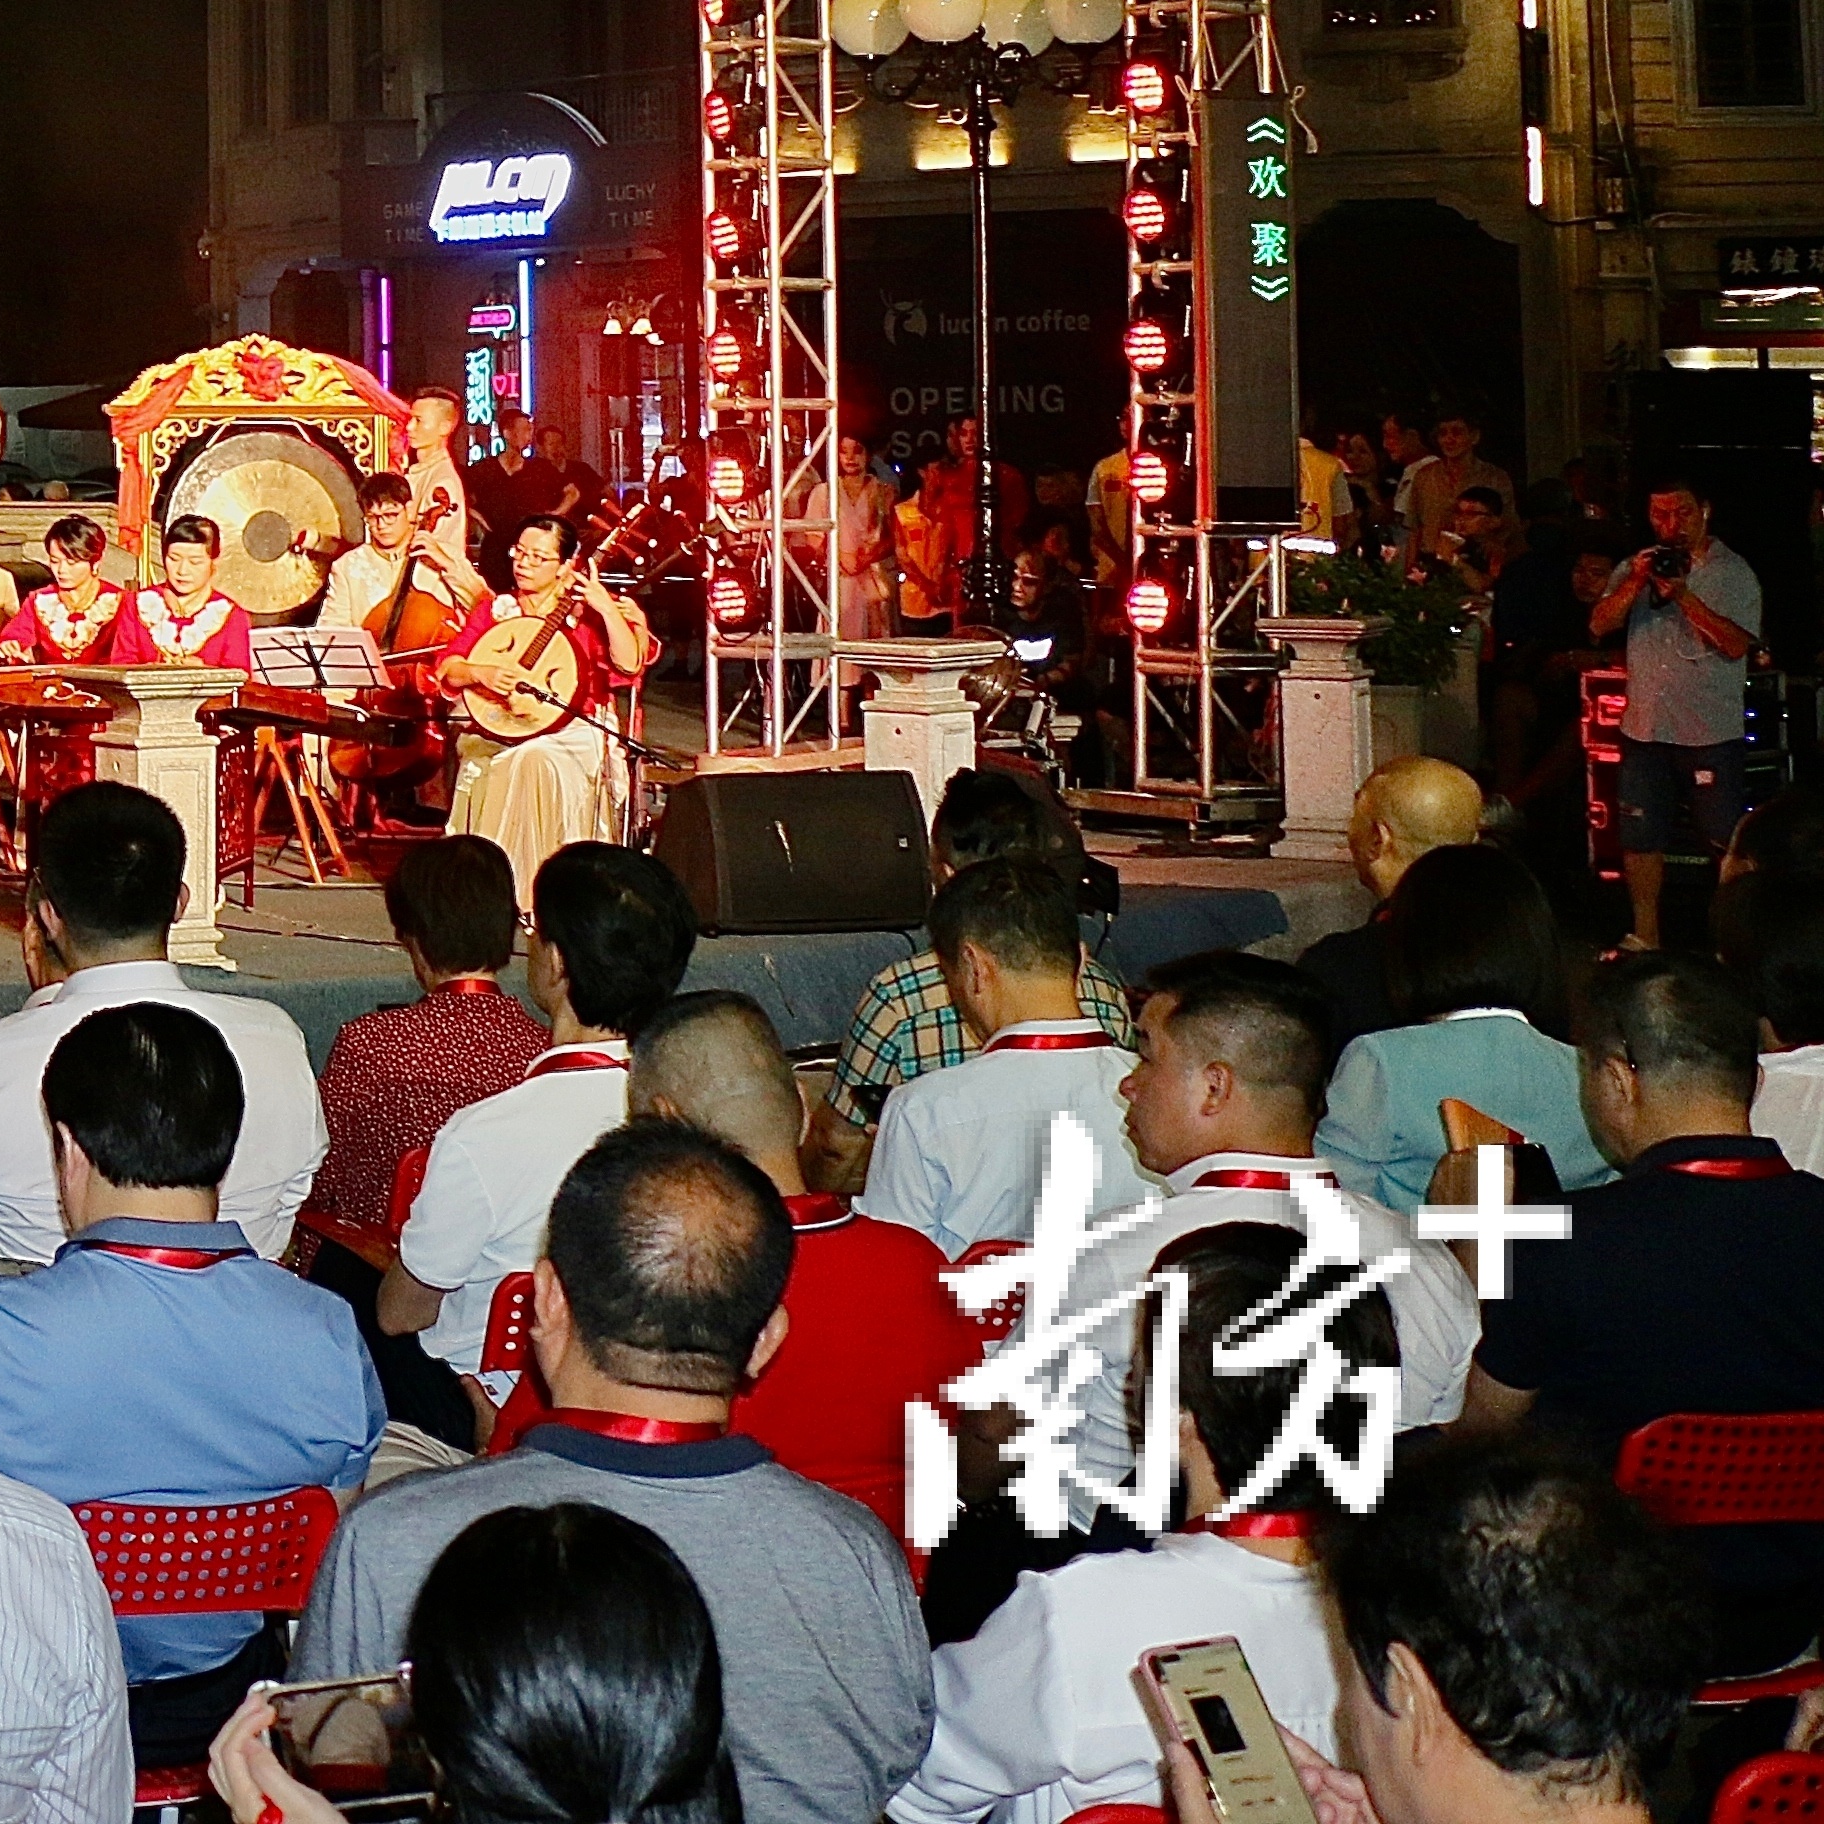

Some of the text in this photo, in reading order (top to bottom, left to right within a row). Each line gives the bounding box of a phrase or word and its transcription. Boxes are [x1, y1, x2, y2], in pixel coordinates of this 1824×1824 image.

[1247, 117, 1289, 302] 《欢聚》
[939, 308, 1091, 336] lucn coffee
[889, 383, 1066, 418] OPEING
